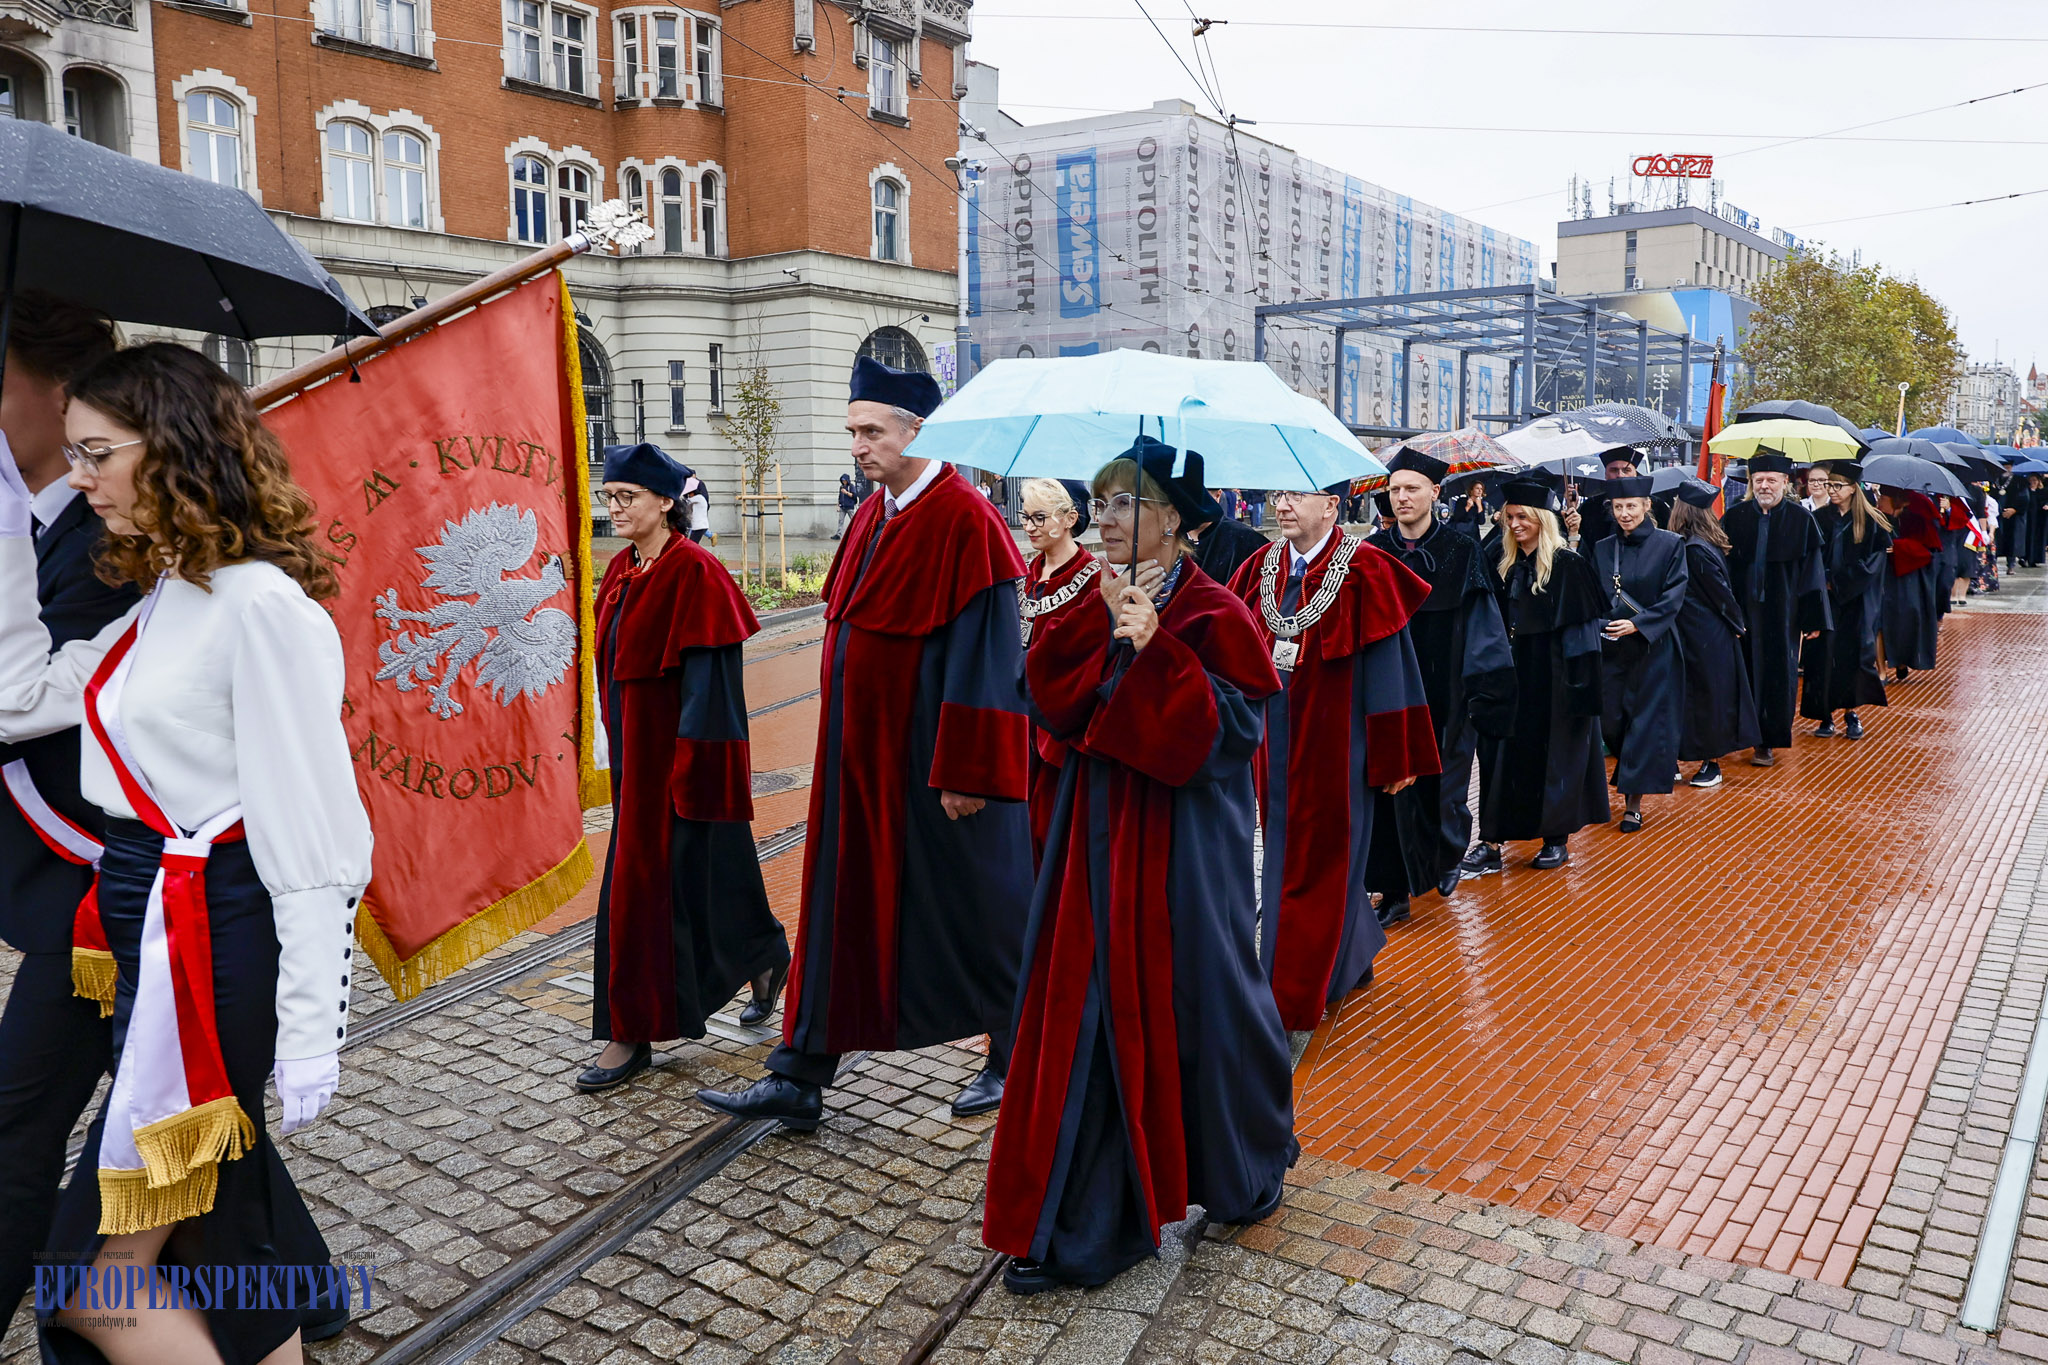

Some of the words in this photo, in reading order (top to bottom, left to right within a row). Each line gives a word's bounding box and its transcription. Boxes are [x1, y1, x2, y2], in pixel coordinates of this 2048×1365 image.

[1014, 153, 1035, 310] OPTOLITH
[1062, 163, 1093, 307] Sewera
[1124, 167, 1132, 225] Professionelle
[1124, 228, 1133, 281] Bauprodukte
[1137, 136, 1161, 305] OPTOLITH
[1187, 118, 1200, 287] OPTOLITH
[1224, 131, 1236, 293] OPTOLITH
[1258, 147, 1270, 304] OPTOLITH
[352, 730, 541, 800] NARODV
